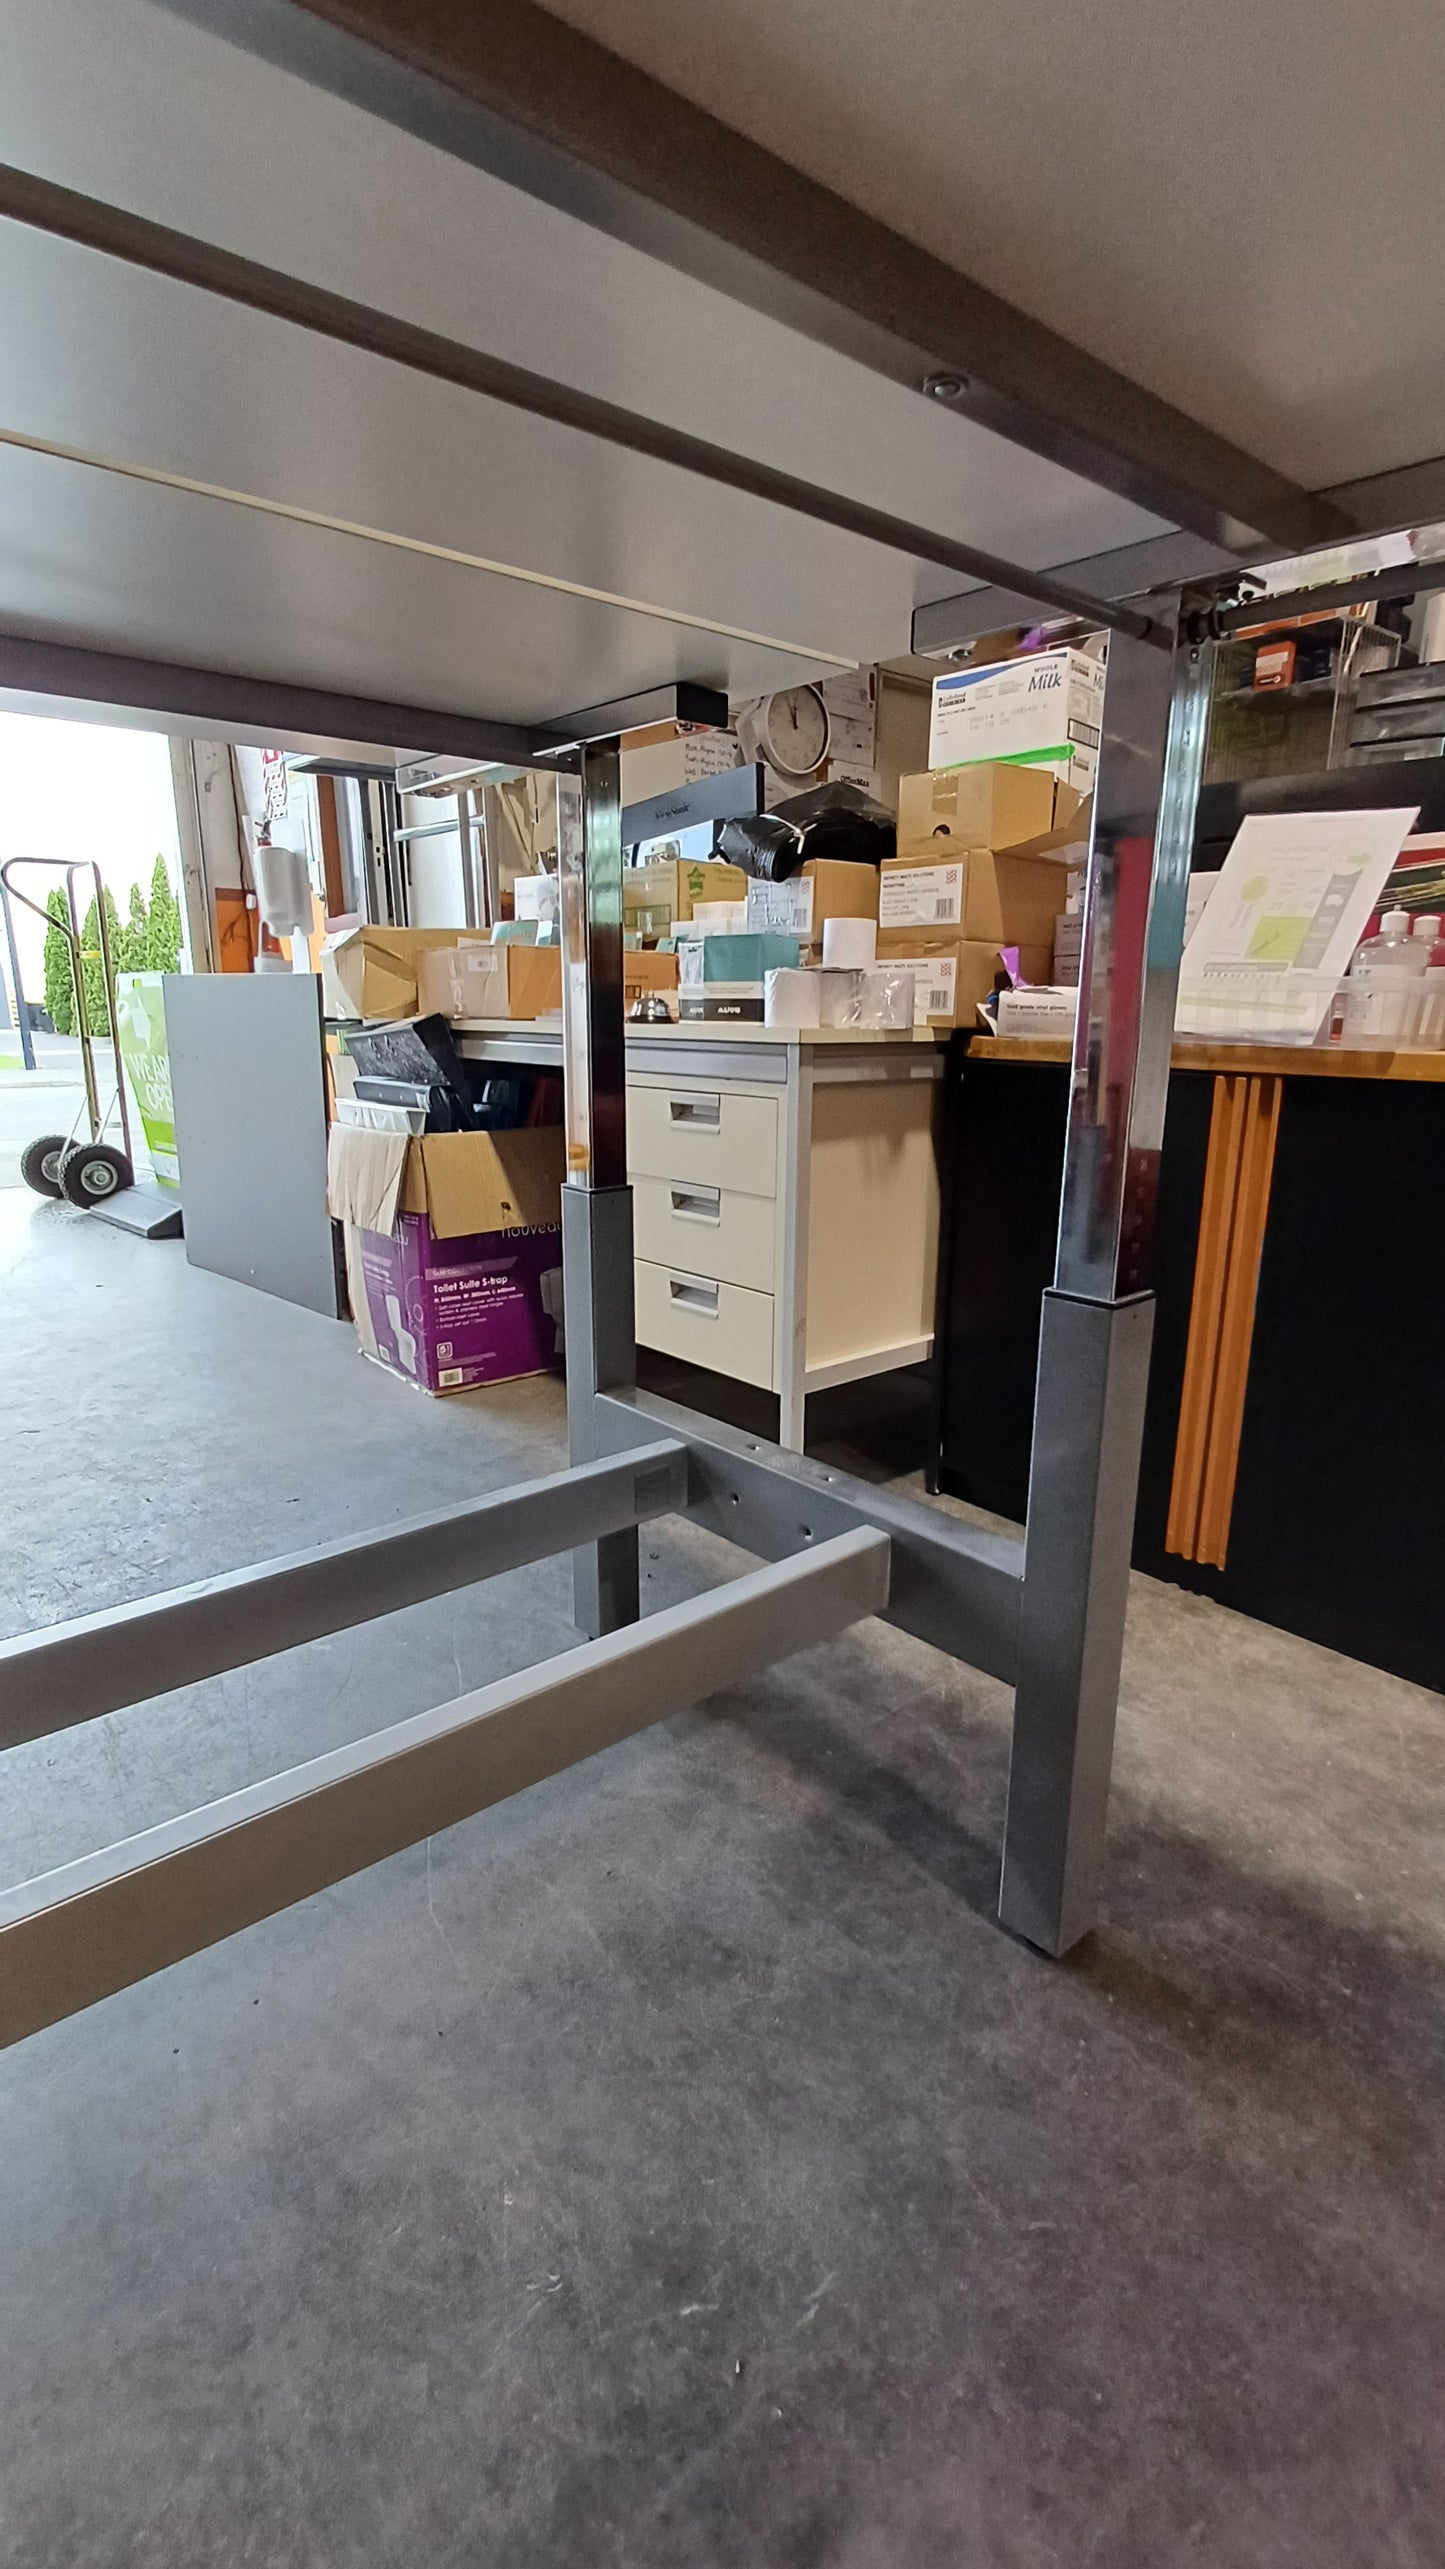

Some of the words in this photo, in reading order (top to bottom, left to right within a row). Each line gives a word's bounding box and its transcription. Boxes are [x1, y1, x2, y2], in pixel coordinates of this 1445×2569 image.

[1034, 664, 1058, 672] WHOLE
[1028, 673, 1062, 692] Milk
[129, 1053, 155, 1081] WE
[151, 1054, 171, 1084] AR
[146, 1082, 174, 1111] OPE
[433, 1282, 458, 1294] Toilet
[459, 1280, 480, 1290] Suite
[482, 1276, 508, 1287] S-trap
